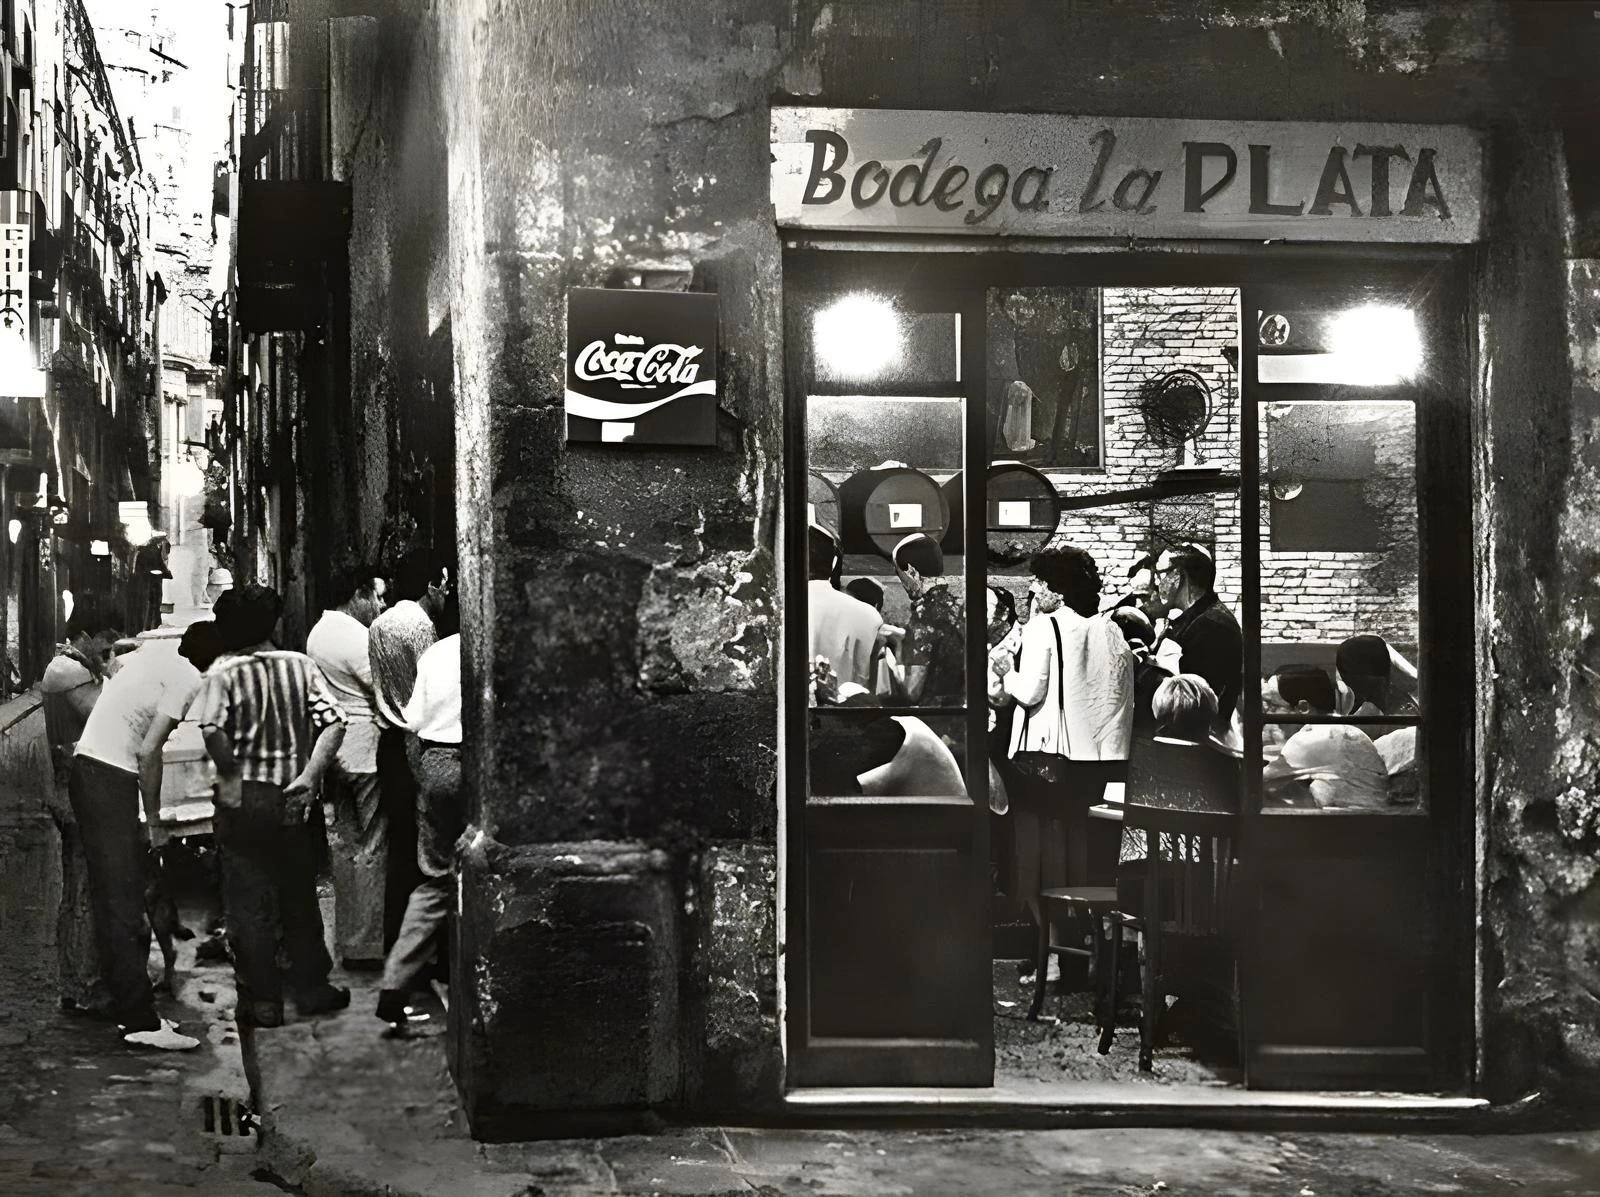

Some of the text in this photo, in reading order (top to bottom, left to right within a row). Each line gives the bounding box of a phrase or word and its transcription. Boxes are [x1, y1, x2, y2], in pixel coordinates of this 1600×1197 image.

[801, 128, 1453, 224] Bodega la PLATA
